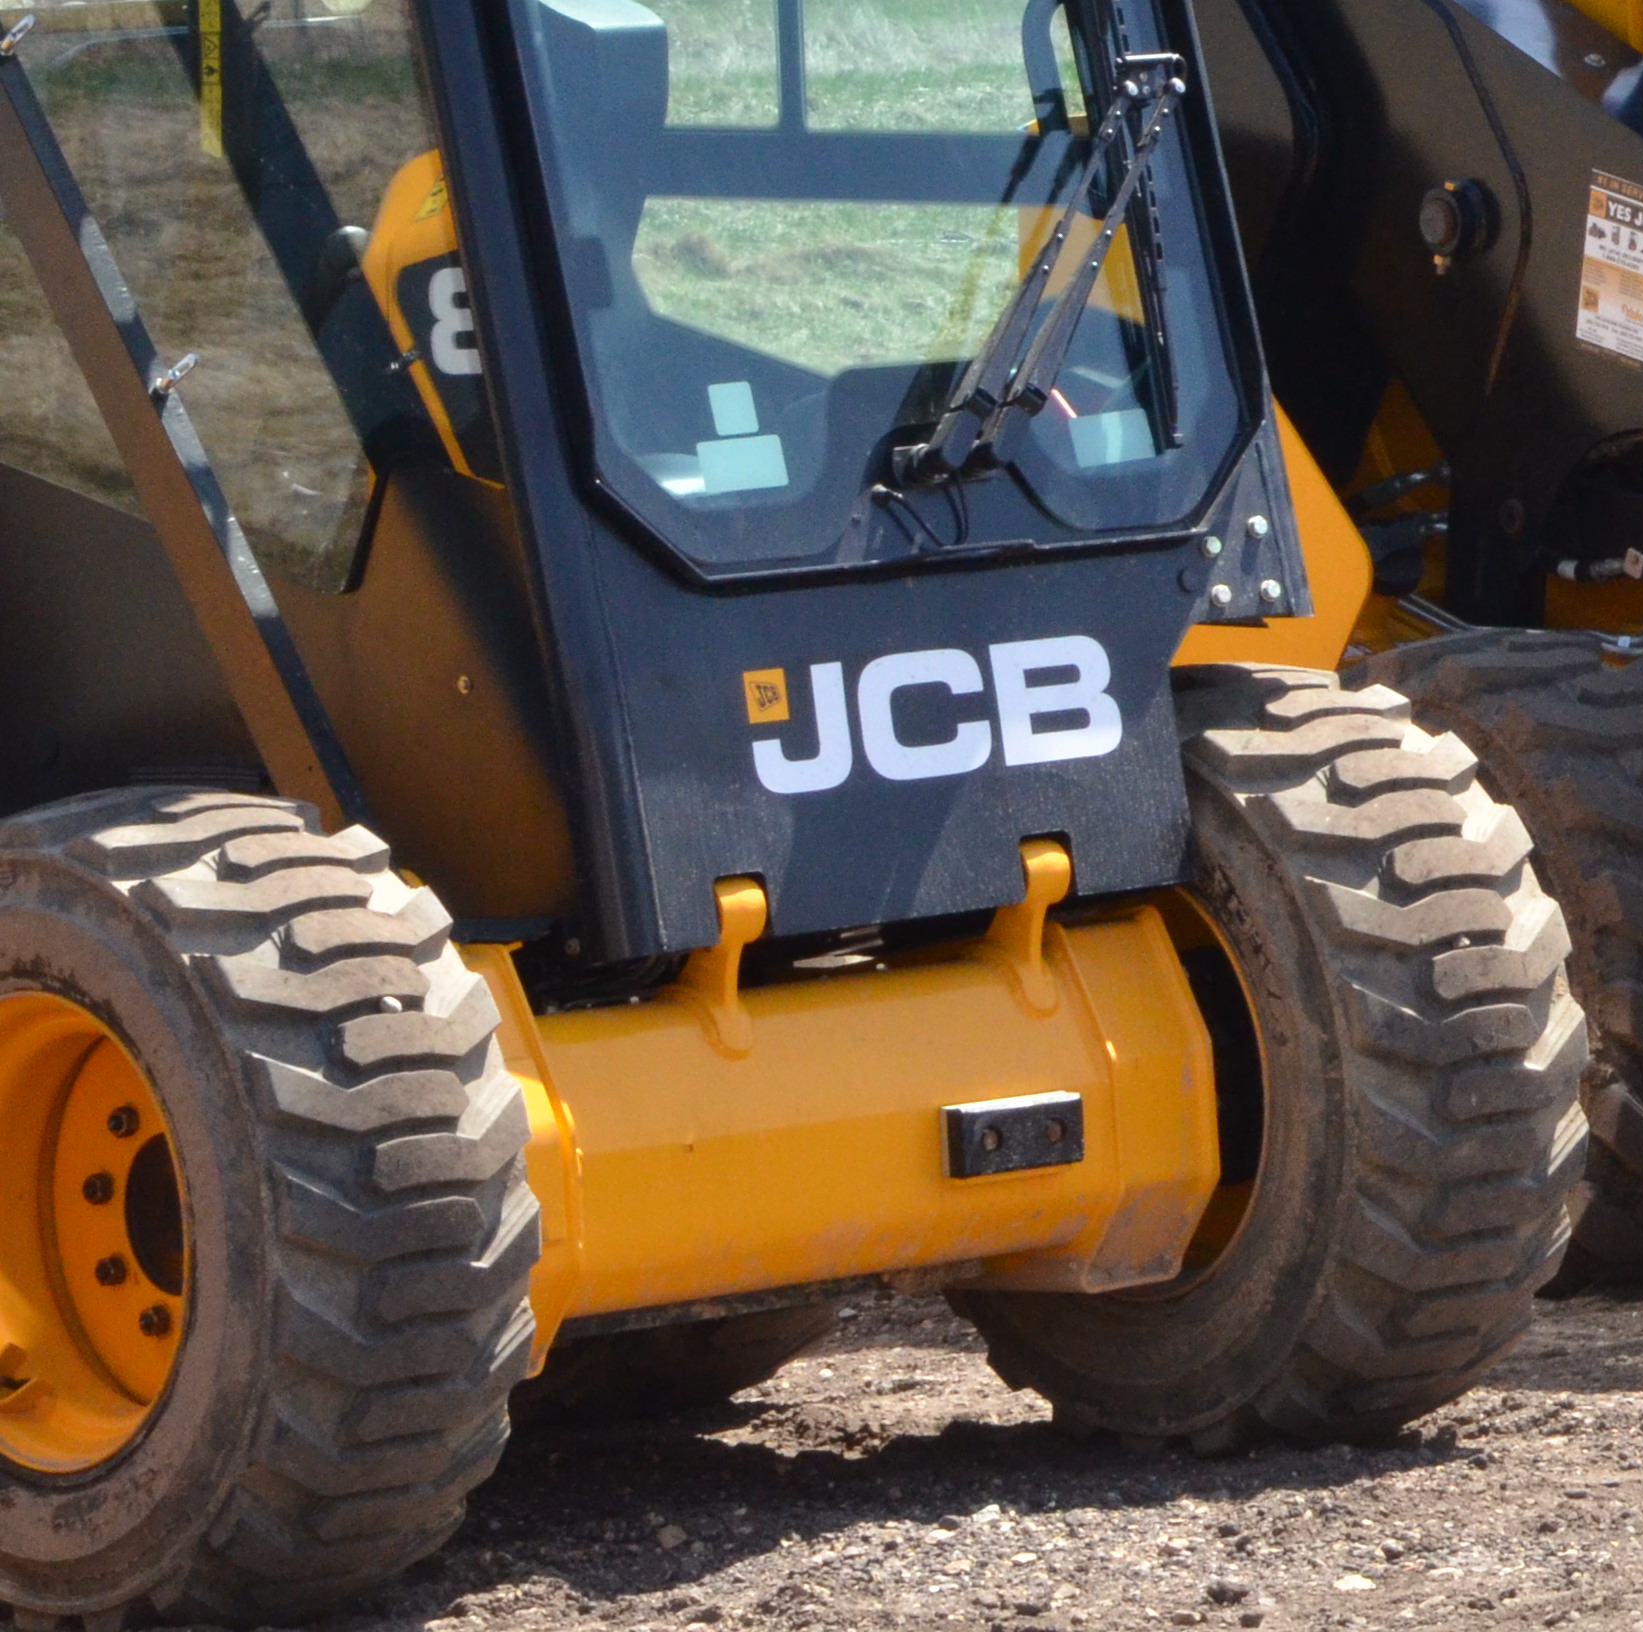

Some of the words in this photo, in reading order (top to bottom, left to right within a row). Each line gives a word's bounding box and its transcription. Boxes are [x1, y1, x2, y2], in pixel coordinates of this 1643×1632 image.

[1607, 200, 1632, 223] YES
[755, 680, 781, 709] JCB
[751, 634, 1124, 795] JCB
